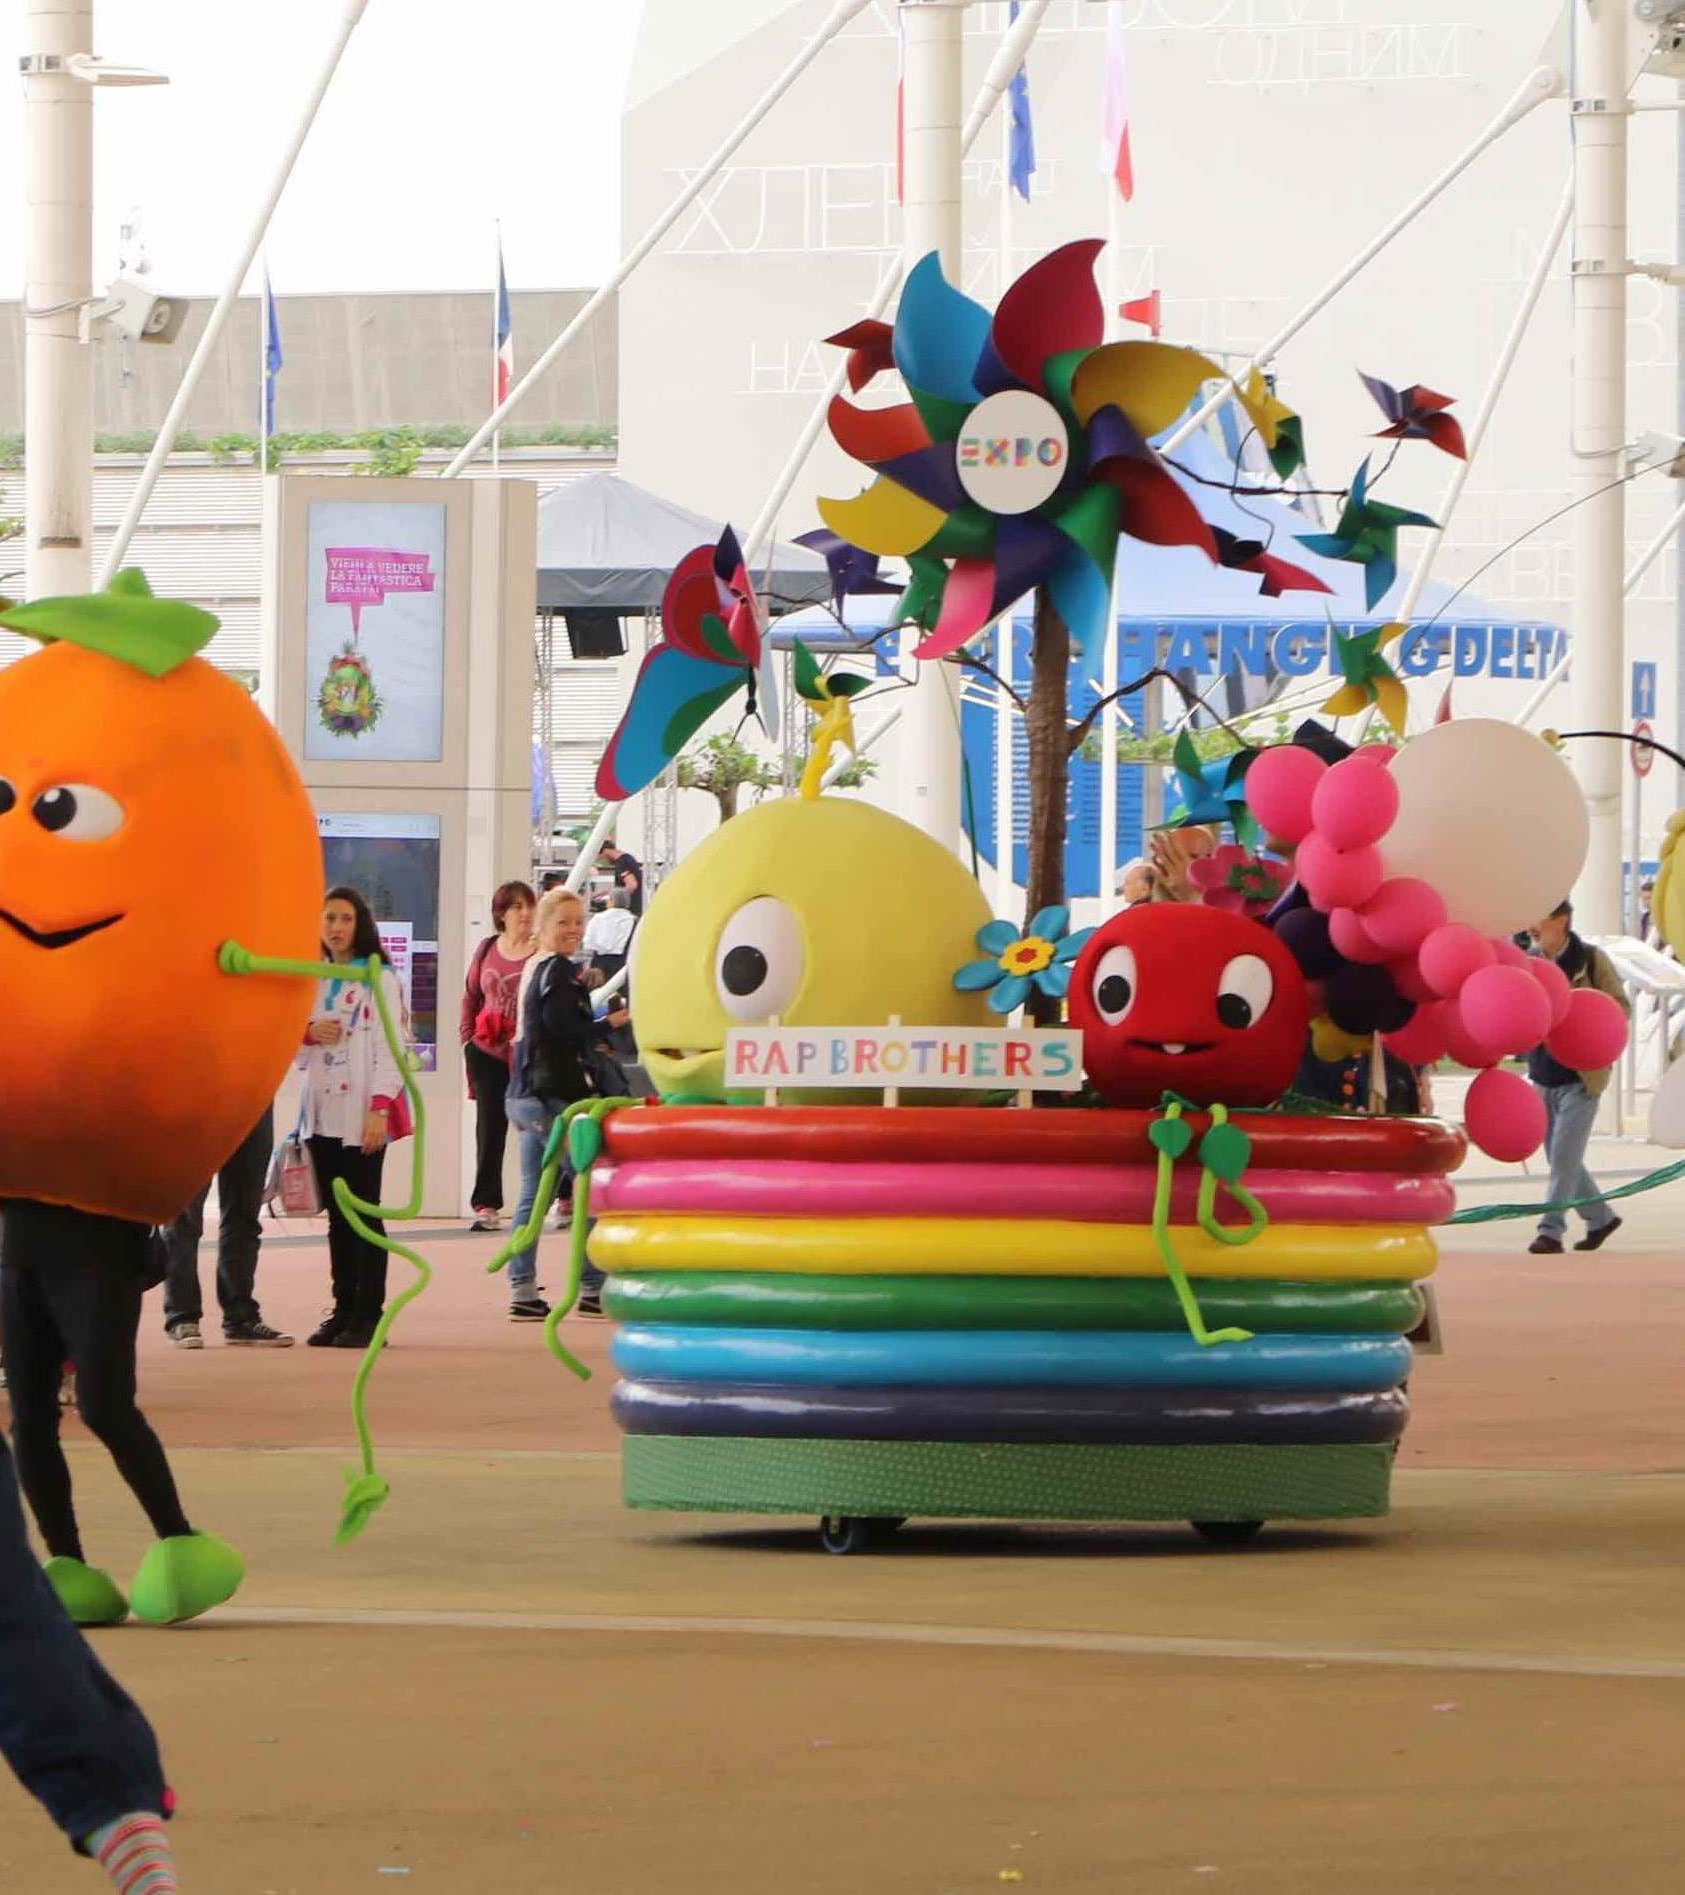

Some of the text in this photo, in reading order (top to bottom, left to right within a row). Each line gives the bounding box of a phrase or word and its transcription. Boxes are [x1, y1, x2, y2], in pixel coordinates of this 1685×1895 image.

[677, 166, 901, 253] ХЛЕ
[960, 437, 1064, 467] EXPO
[734, 1038, 1074, 1077] RAP BROTHERS
